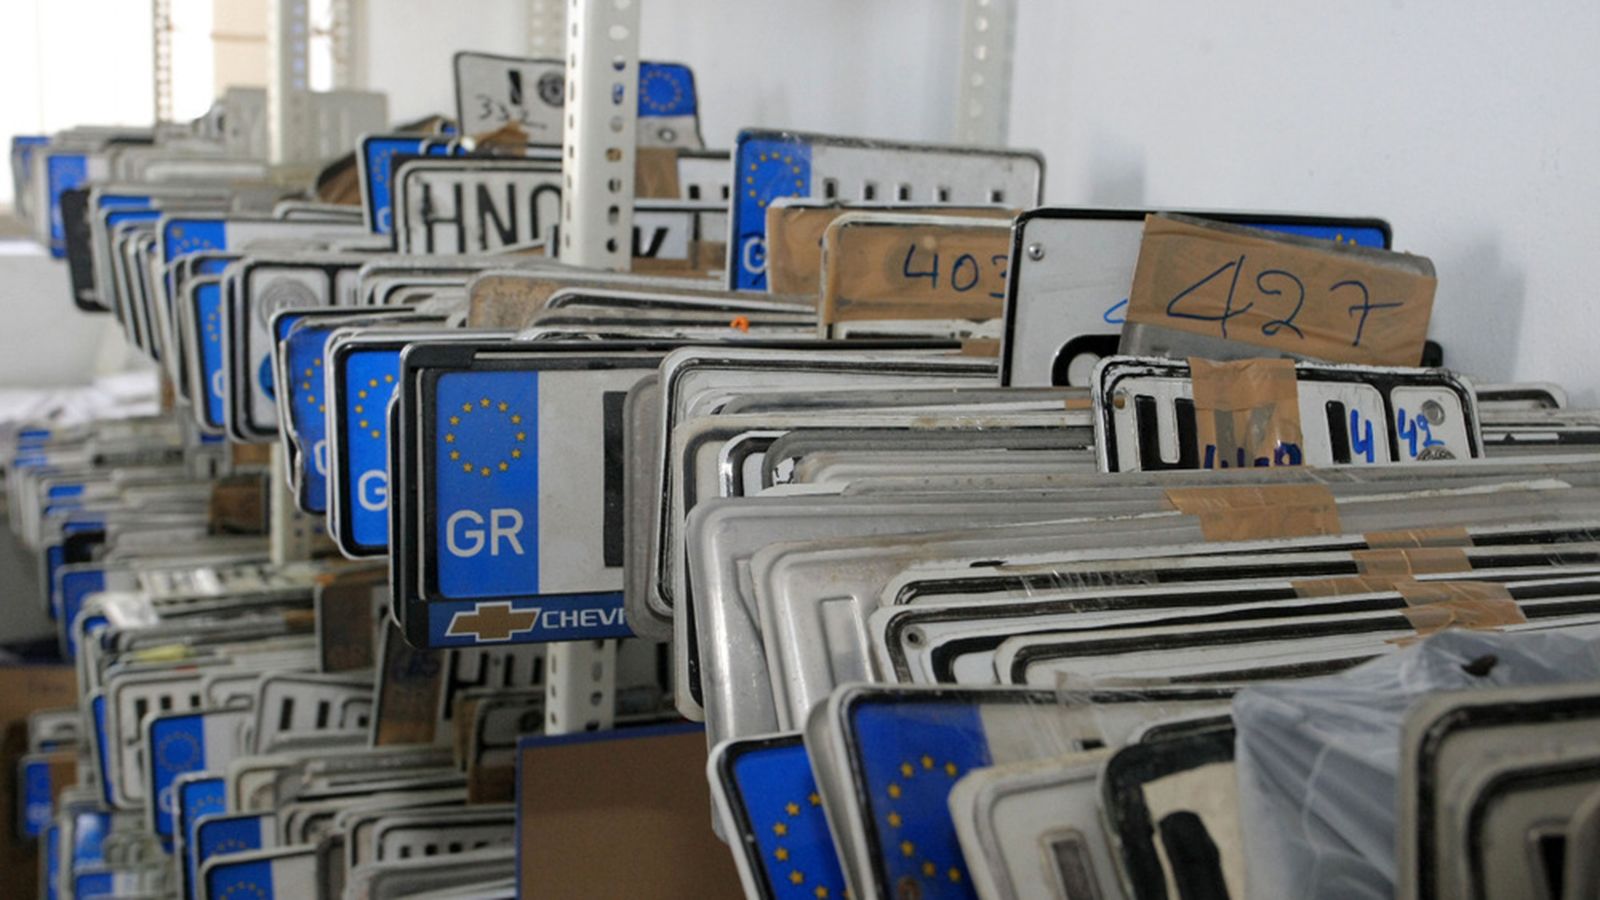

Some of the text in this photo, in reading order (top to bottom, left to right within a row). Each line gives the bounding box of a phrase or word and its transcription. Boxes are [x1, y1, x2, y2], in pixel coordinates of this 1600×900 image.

[743, 237, 767, 274] G
[1167, 255, 1404, 347] 427
[358, 470, 388, 511] G
[446, 508, 525, 557] GR
